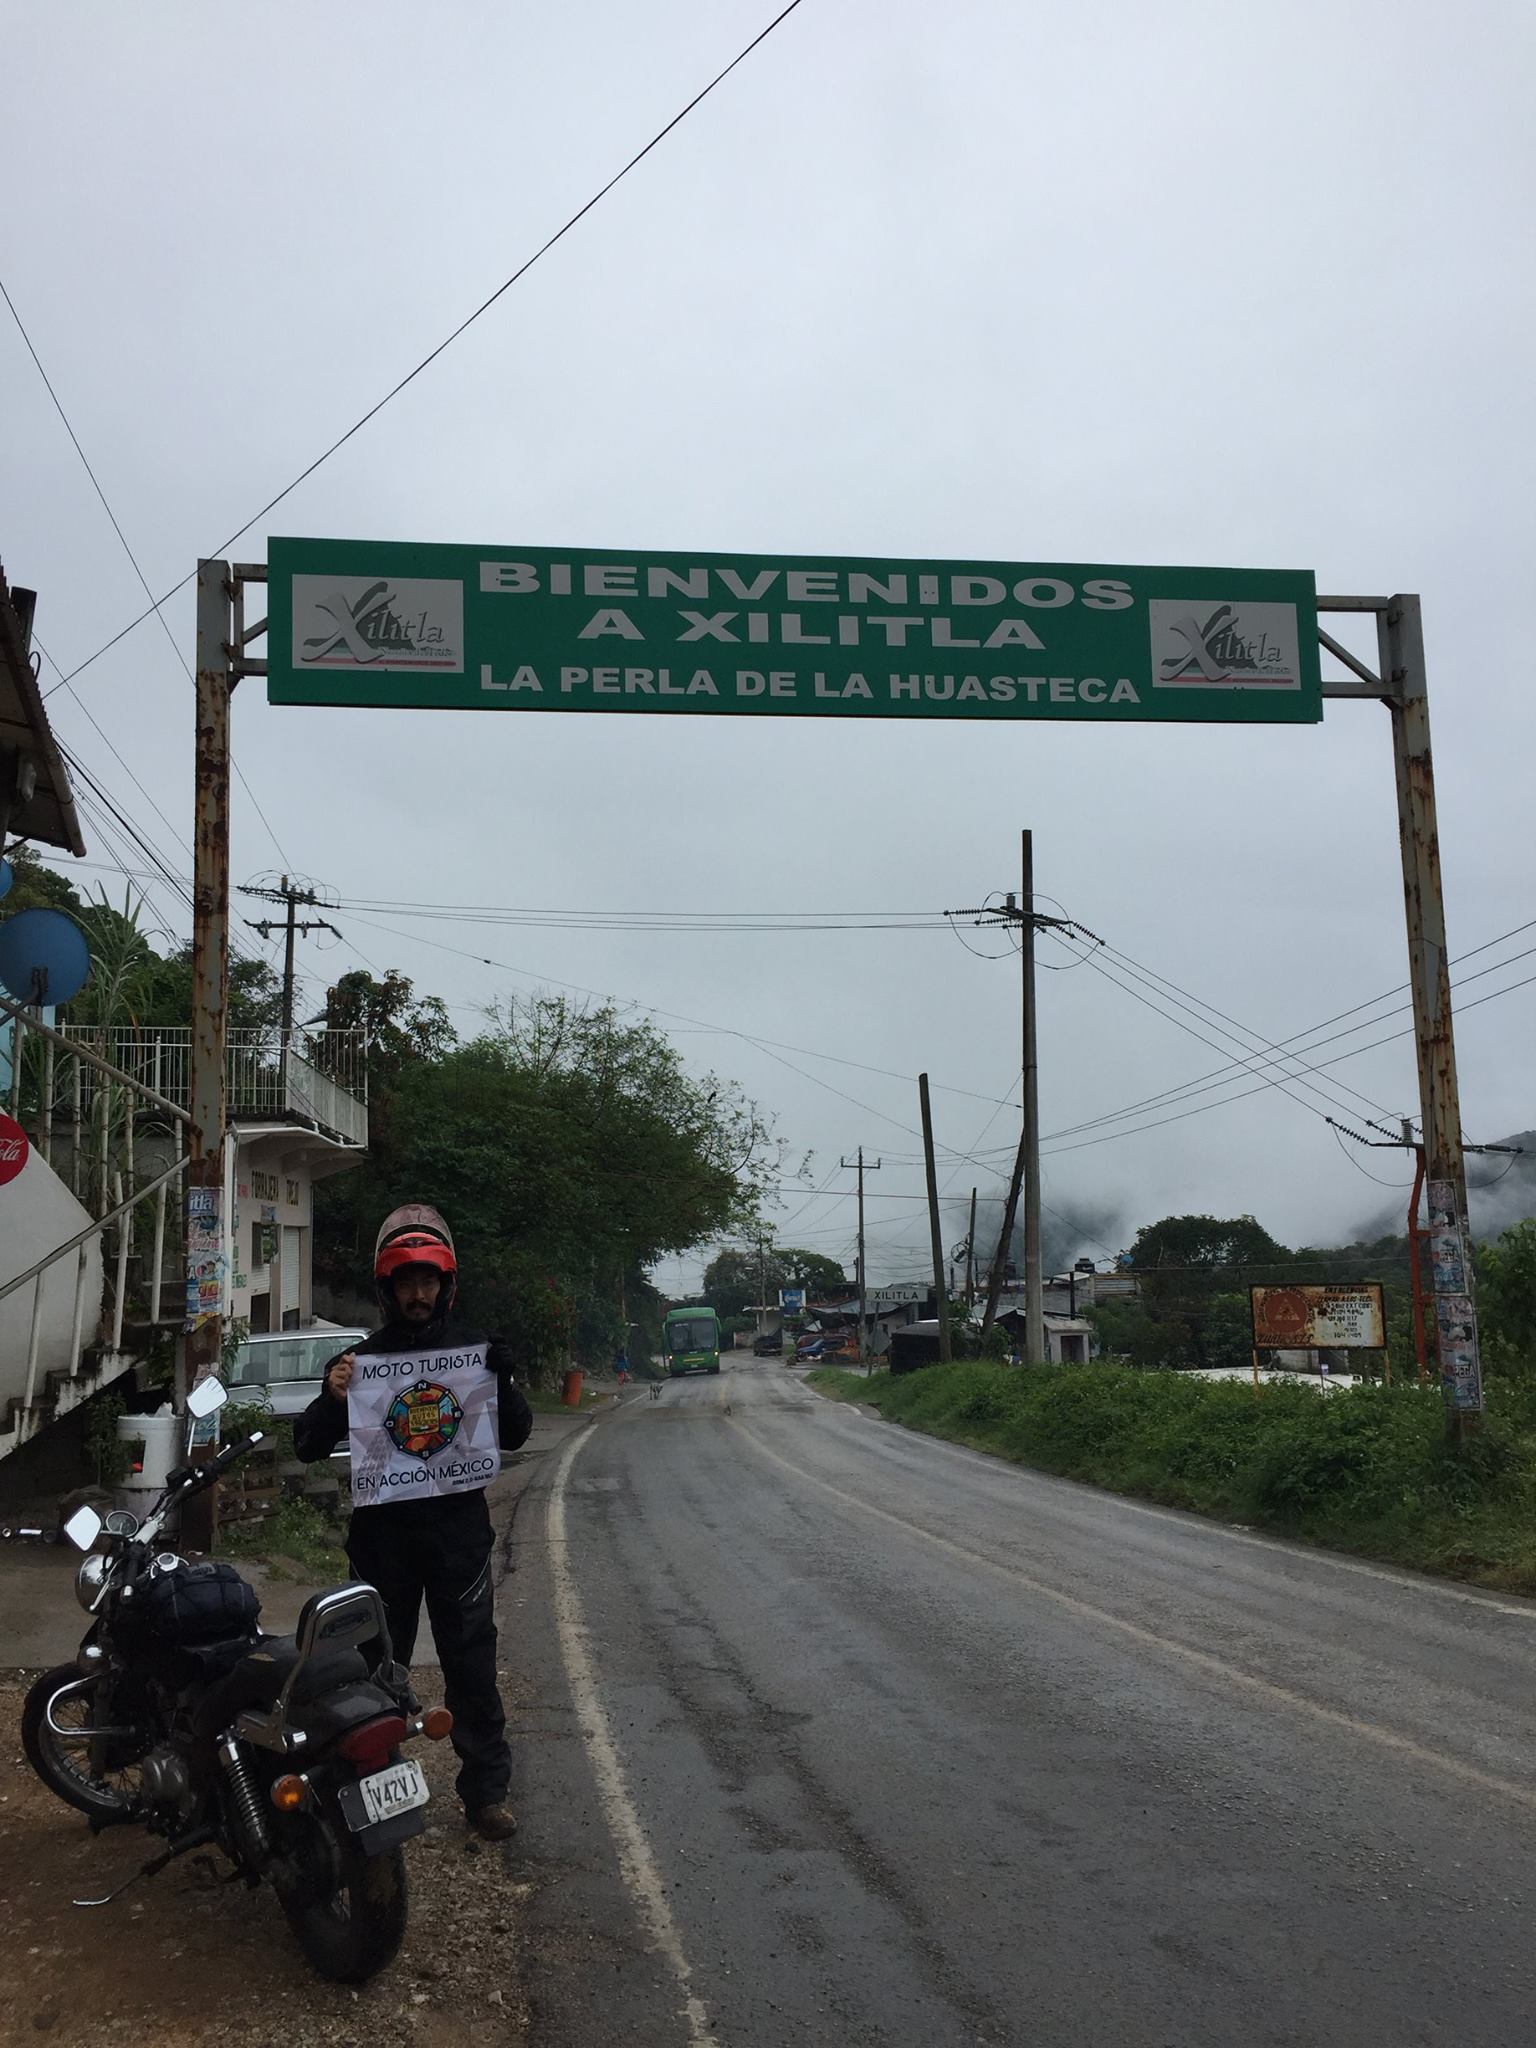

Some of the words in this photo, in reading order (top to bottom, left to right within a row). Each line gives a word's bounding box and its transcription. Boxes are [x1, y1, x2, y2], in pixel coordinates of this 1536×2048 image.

[479, 561, 1135, 610] BIENVENIDOS
[301, 582, 446, 664] Xilitla
[577, 609, 645, 640] A
[676, 610, 1047, 650] XILITLA
[1160, 604, 1284, 682] Xilitla
[480, 664, 543, 691] LA
[560, 666, 720, 695] PERLA
[736, 671, 797, 697] DE
[814, 673, 874, 698] LA
[889, 673, 1141, 704] HUASTECA
[874, 1291, 918, 1300] XILITLA
[362, 1361, 414, 1380] MOTO
[418, 1352, 482, 1374] TURISTA
[357, 1475, 376, 1490] EN
[378, 1468, 436, 1488] ACCIÓN
[439, 1457, 494, 1479] MÉXICO
